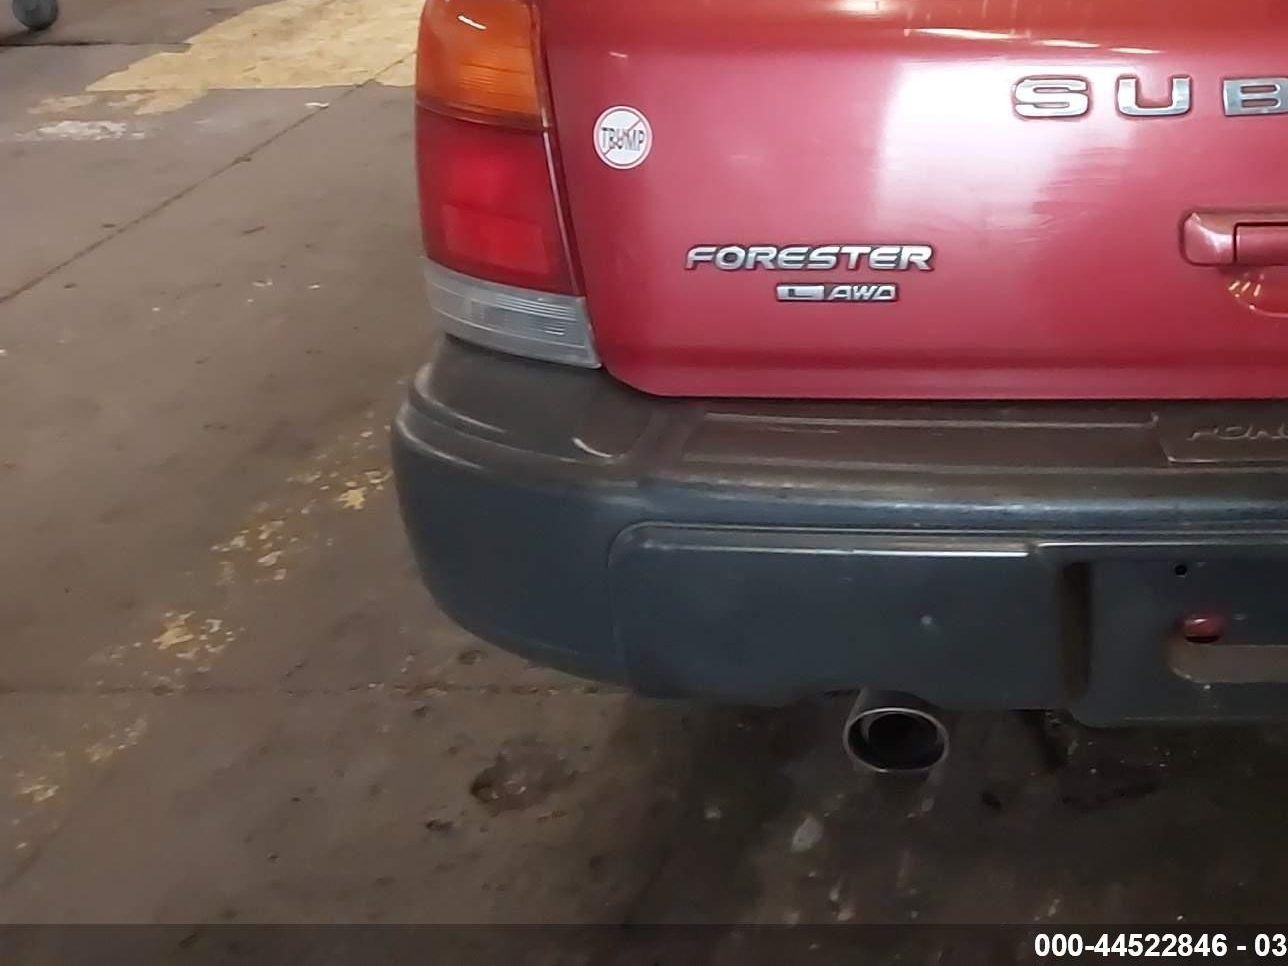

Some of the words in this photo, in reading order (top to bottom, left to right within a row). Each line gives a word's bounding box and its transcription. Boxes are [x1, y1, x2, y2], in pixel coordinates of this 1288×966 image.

[601, 126, 645, 151] TRUMP
[685, 245, 934, 271] FORESTER
[827, 284, 897, 302] AWD
